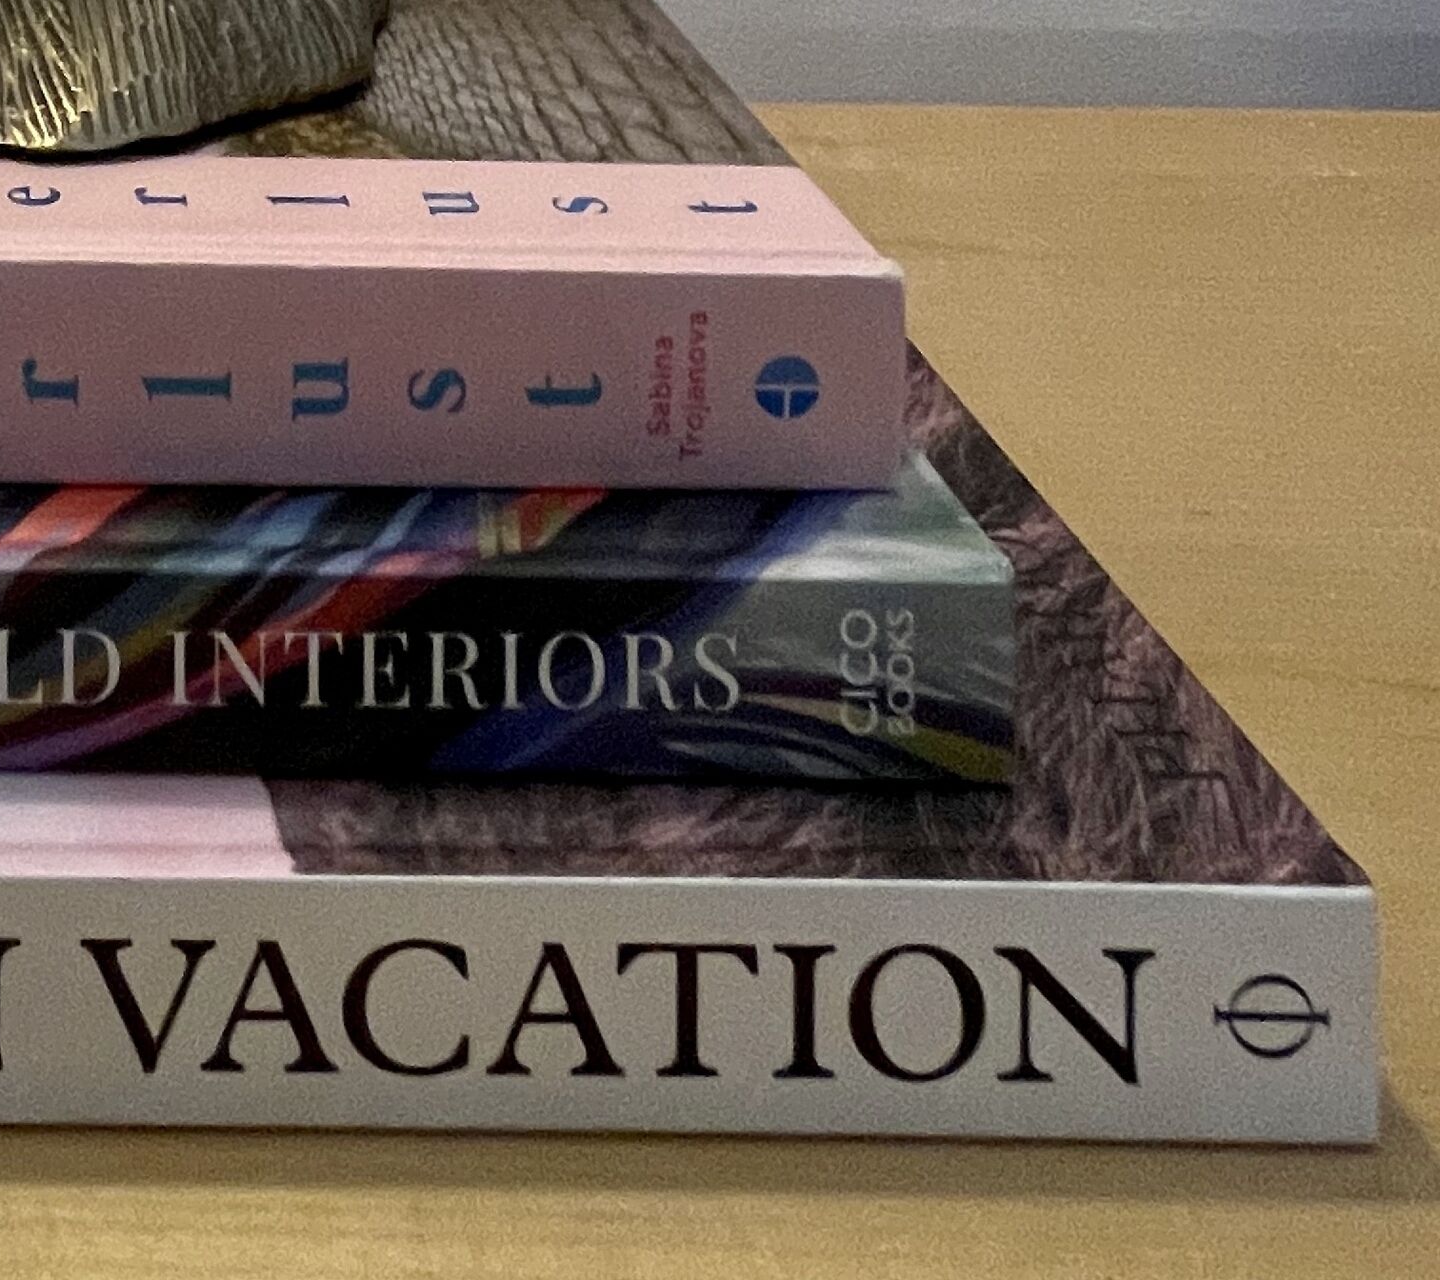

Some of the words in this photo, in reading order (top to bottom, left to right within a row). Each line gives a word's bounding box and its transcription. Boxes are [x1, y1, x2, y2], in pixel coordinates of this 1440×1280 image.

[646, 335, 674, 436] Sabina
[678, 311, 711, 461] Trojanova
[163, 629, 743, 712] INTERIORS
[840, 609, 878, 735] CICO
[886, 609, 915, 736] BOOKS
[80, 938, 1156, 1086] VACATION
